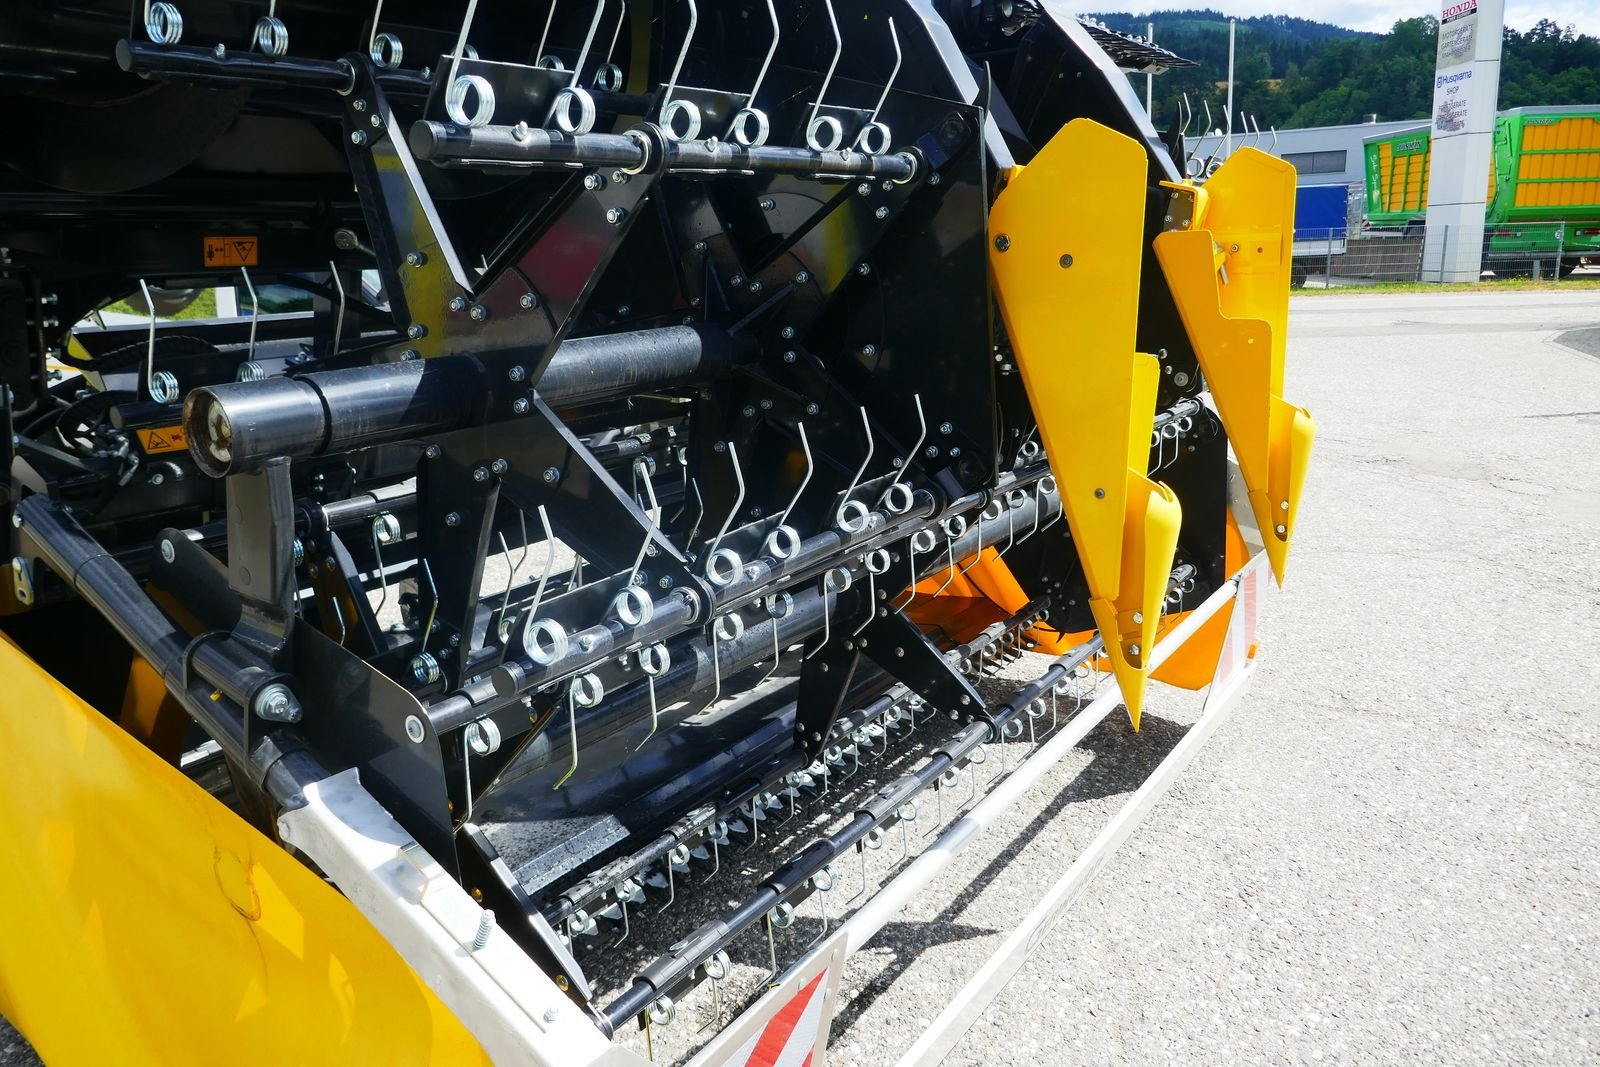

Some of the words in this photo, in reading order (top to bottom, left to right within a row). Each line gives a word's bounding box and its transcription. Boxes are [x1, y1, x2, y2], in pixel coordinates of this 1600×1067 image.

[1442, 0, 1477, 18] HONDA
[1443, 71, 1472, 84] Husqvarna
[1446, 86, 1459, 95] SHOP
